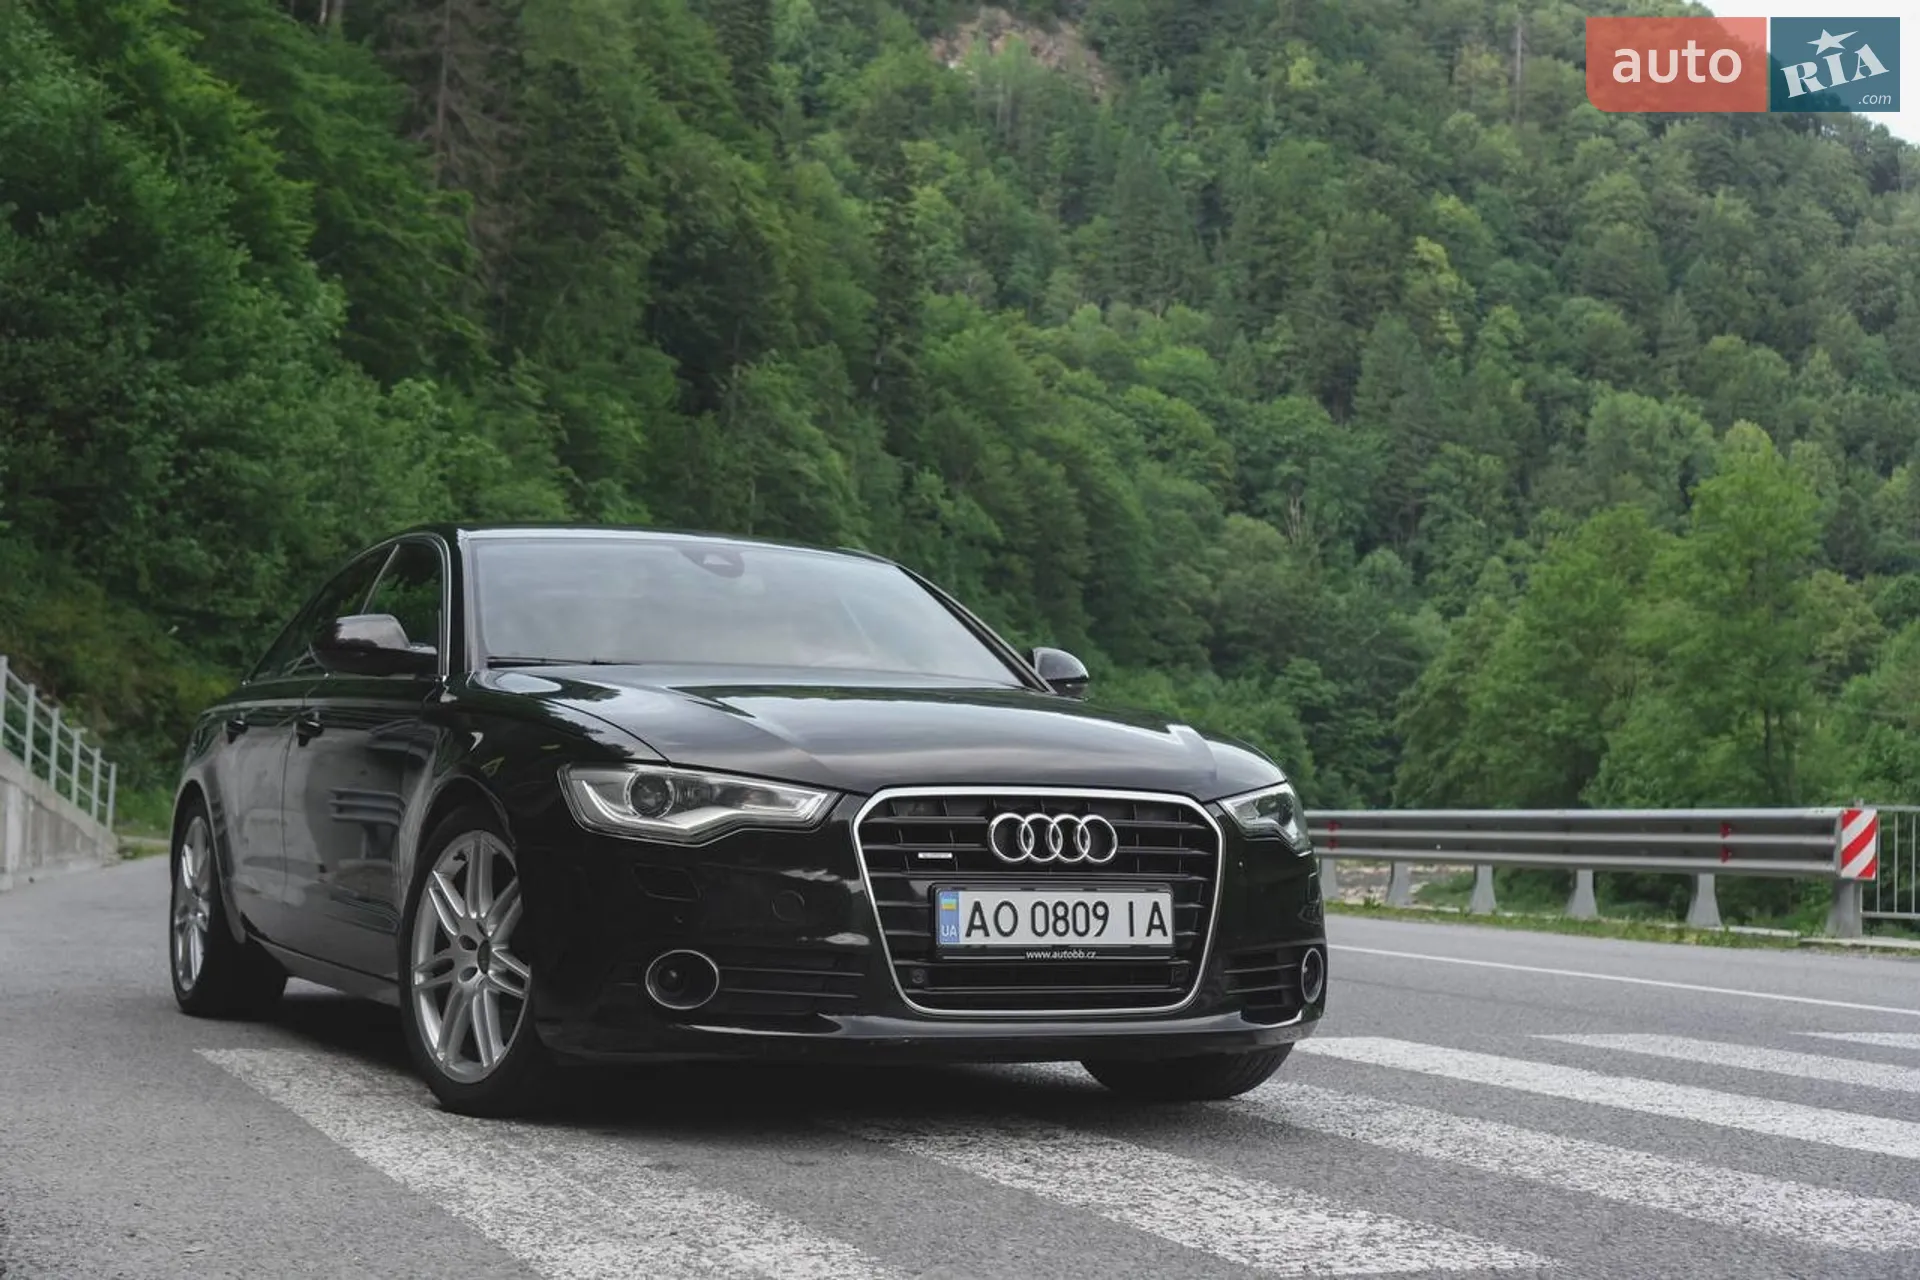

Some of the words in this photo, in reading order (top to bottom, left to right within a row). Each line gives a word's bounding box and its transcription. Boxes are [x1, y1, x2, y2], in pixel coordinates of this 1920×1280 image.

[965, 901, 1018, 937] AO
[1030, 901, 1110, 937] 0809
[1128, 901, 1168, 937] IA
[941, 926, 958, 937] UA
[1026, 951, 1097, 959] www.autobb.cz
